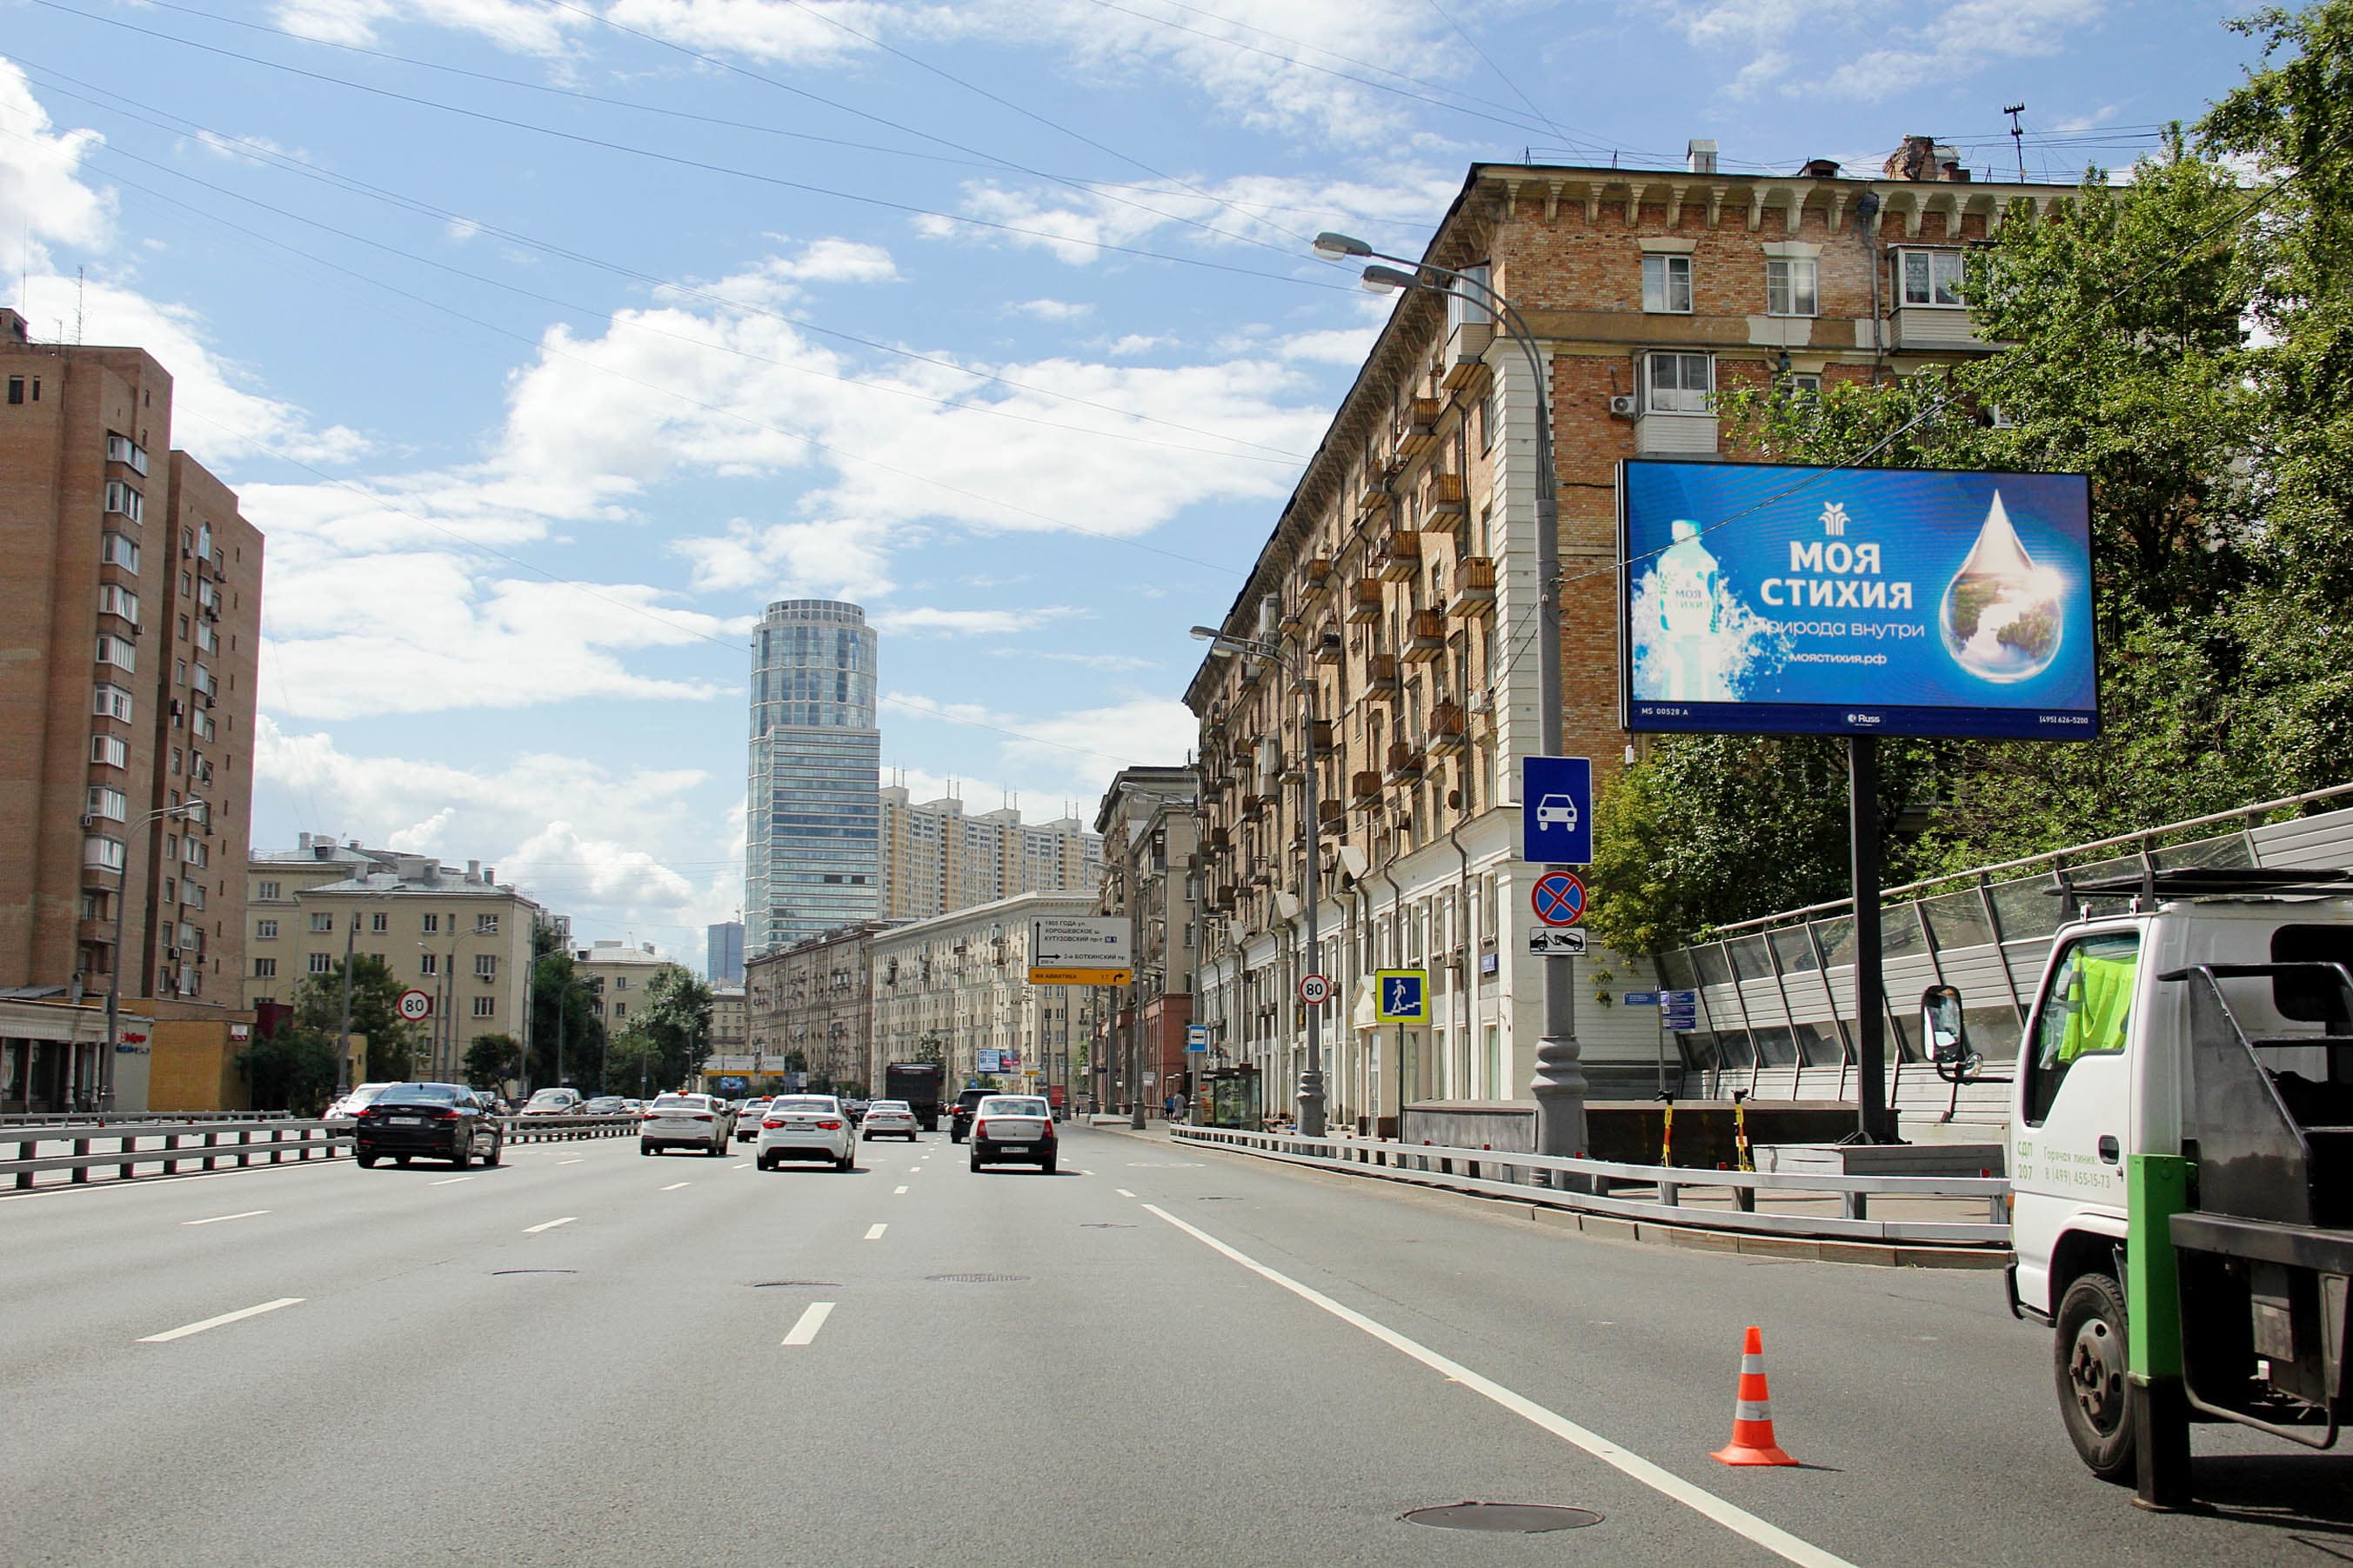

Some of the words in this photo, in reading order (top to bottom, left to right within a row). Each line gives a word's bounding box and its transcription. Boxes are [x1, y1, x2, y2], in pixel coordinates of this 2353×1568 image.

[1789, 541, 1881, 574] МОЯ
[1760, 577, 1914, 610] СТИХИЯ
[1850, 622, 1926, 639] внутри
[1789, 652, 1887, 665] моястихия.рф
[1857, 713, 1881, 723] Russ
[2039, 715, 2057, 724] (495)
[2057, 716, 2089, 724] 626-5200
[1307, 983, 1323, 996] 80
[405, 999, 424, 1012] 80
[2017, 1140, 2033, 1158] СДП
[2042, 1145, 2071, 1163] Горячая
[2017, 1164, 2033, 1181] 207
[2045, 1167, 2050, 1180] 8
[2052, 1168, 2072, 1187] (499)
[2074, 1170, 2111, 1189] 455-15-73
